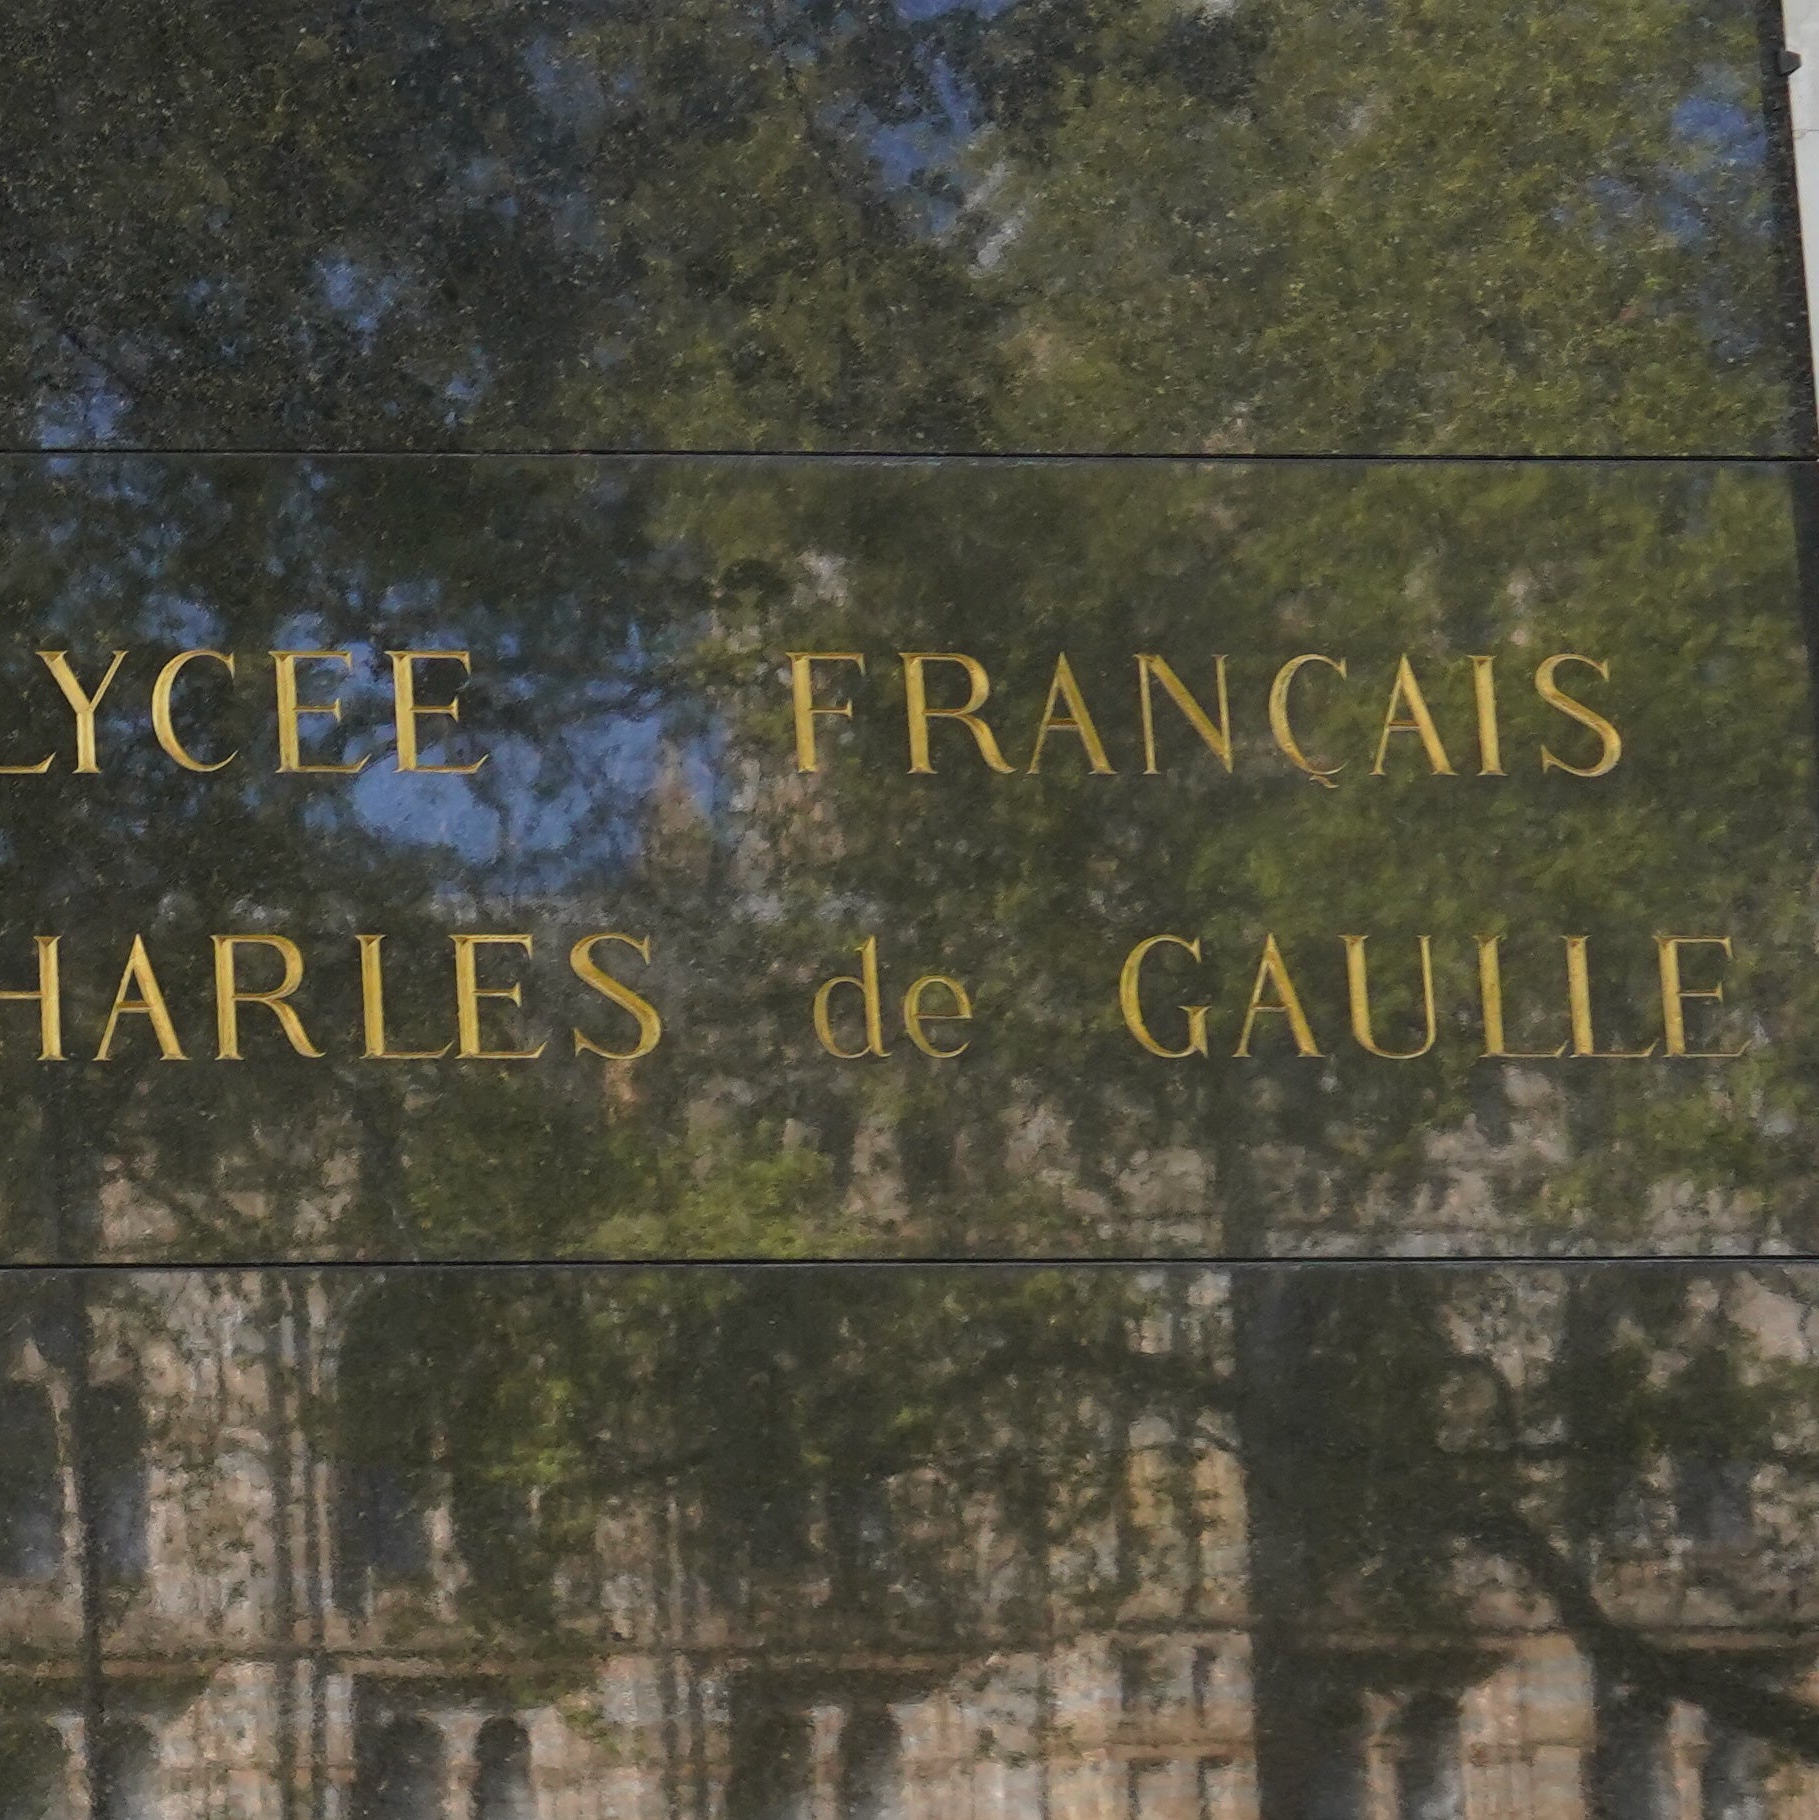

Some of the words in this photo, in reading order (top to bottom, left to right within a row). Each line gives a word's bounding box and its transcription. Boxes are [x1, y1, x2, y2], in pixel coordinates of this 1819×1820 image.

[786, 649, 1625, 789] FRANÇAIS
[811, 935, 974, 1060] de
[1119, 932, 1754, 1063] GAULLE
